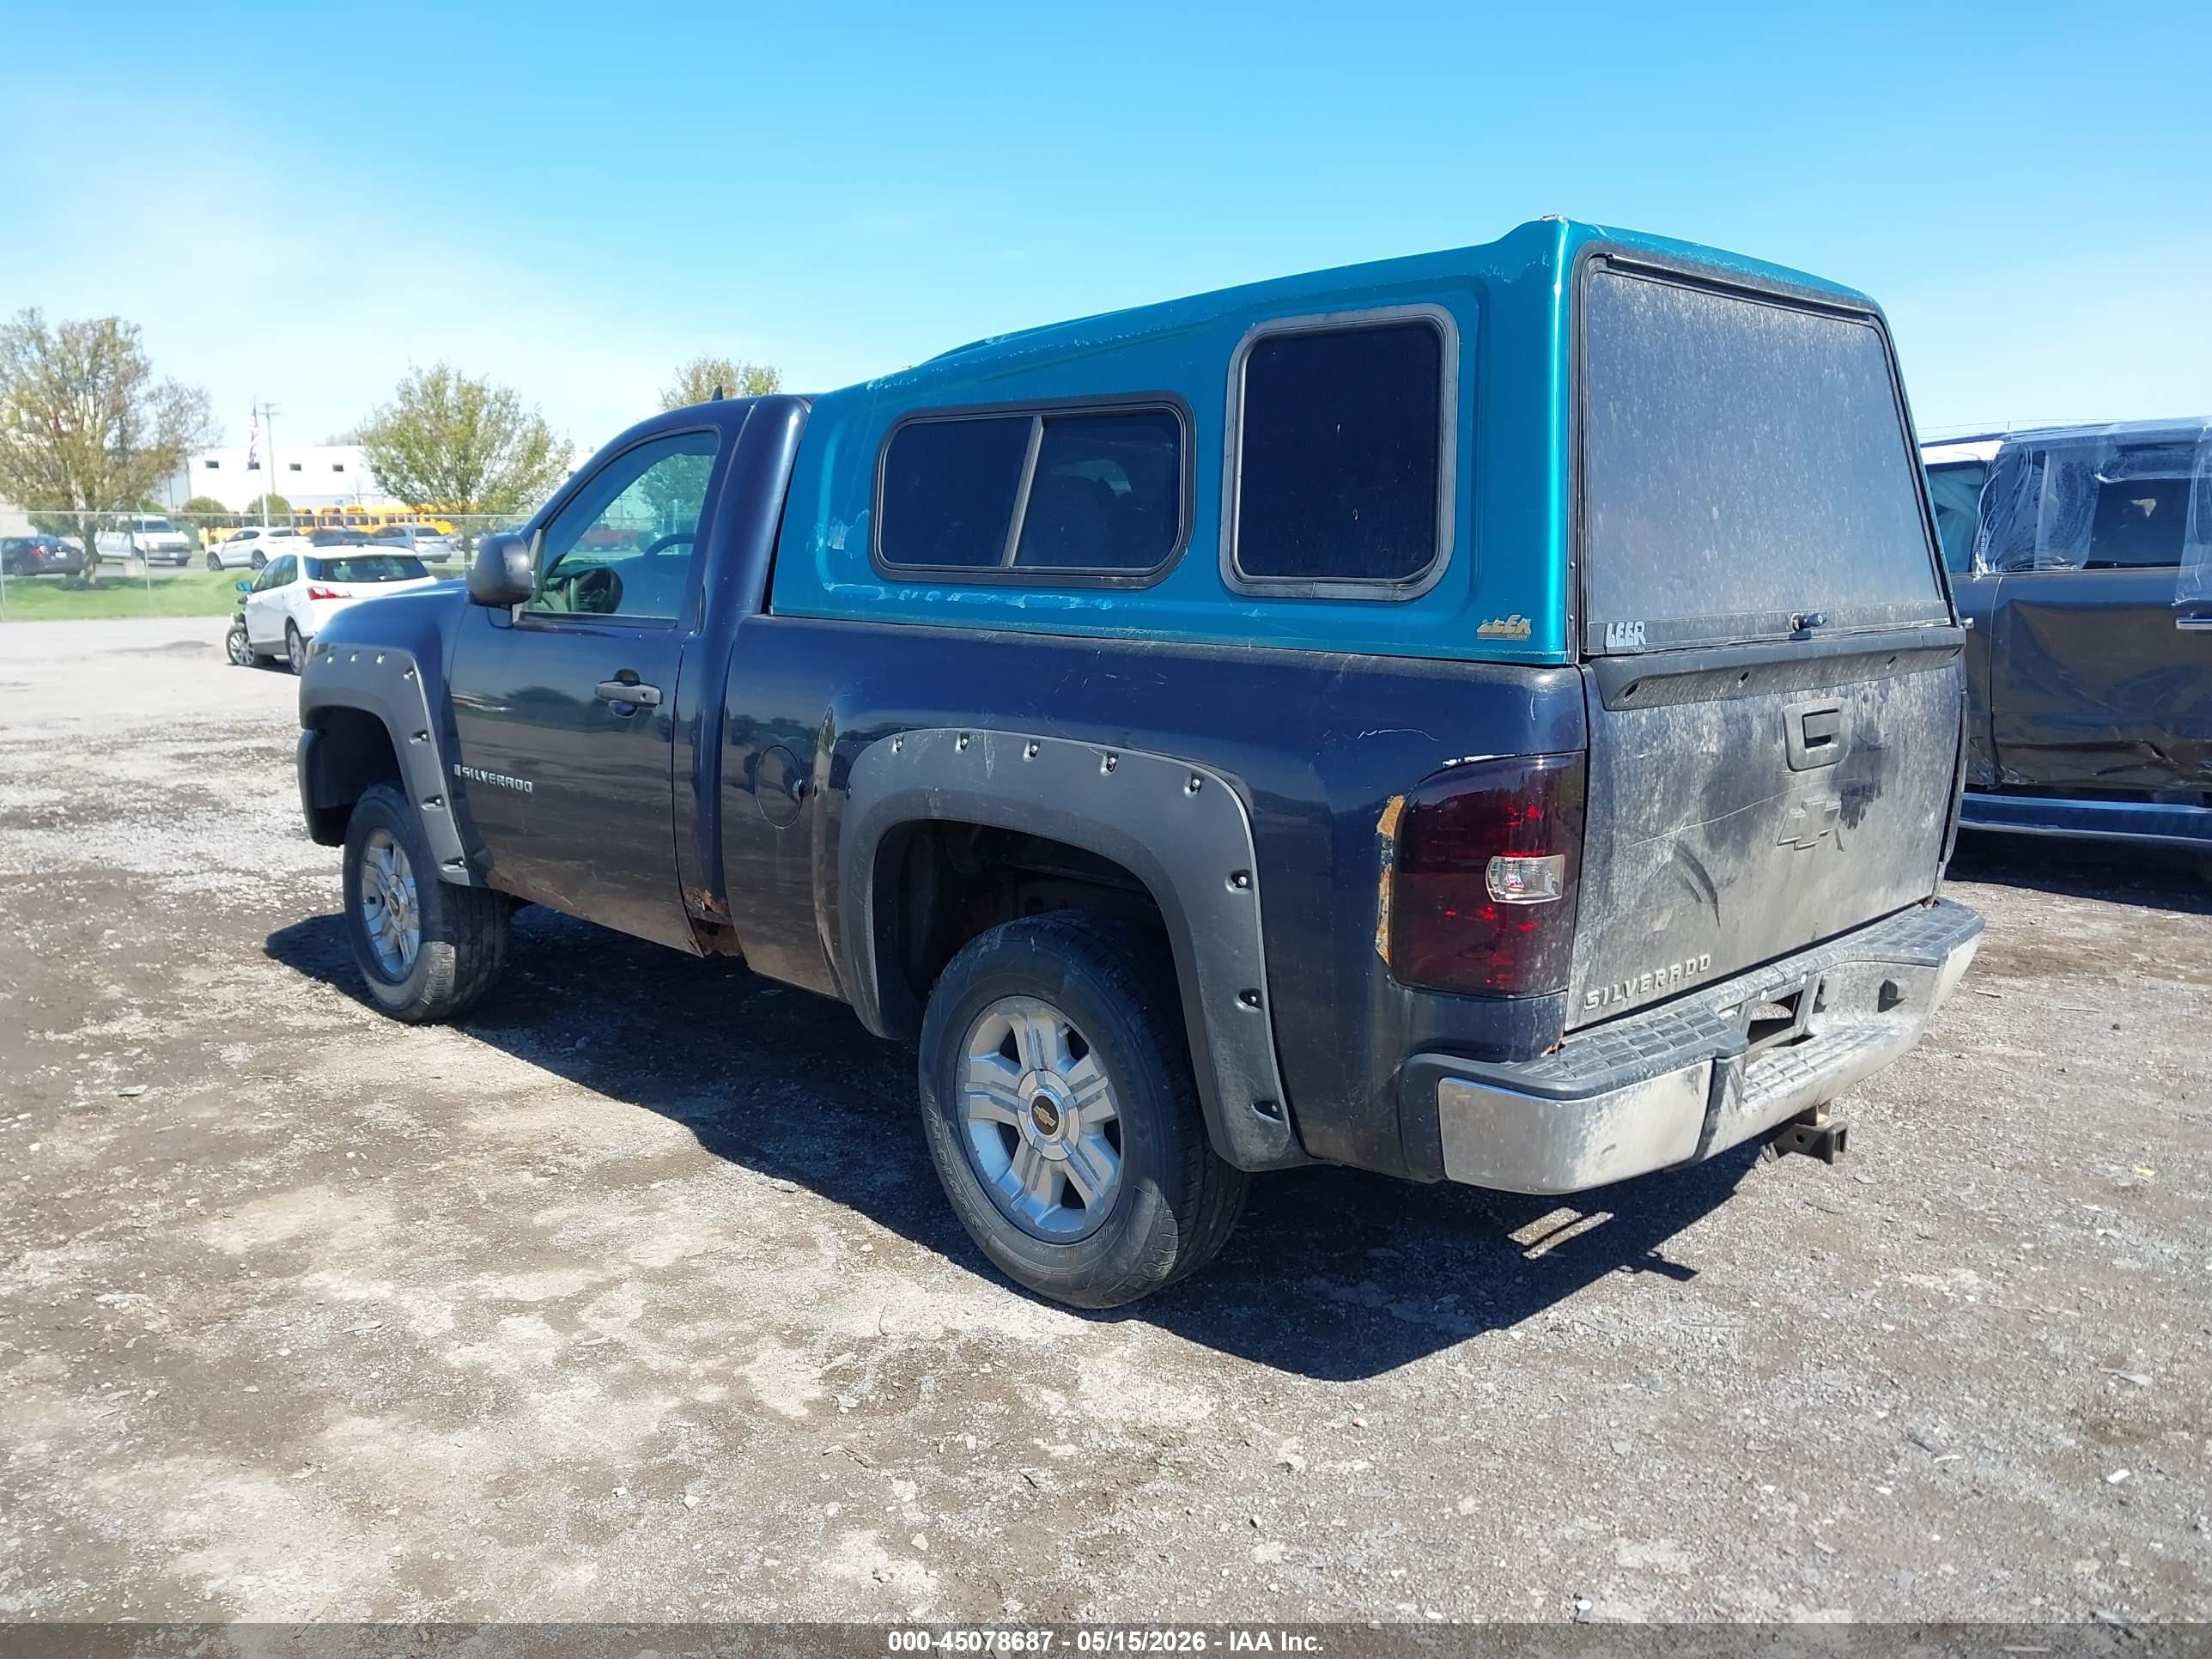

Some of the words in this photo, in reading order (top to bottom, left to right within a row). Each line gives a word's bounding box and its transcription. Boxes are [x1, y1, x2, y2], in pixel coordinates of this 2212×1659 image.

[1606, 620, 1646, 647] LEER
[462, 767, 532, 793] SILVERADO
[1583, 953, 1711, 1012] SILVERADO
